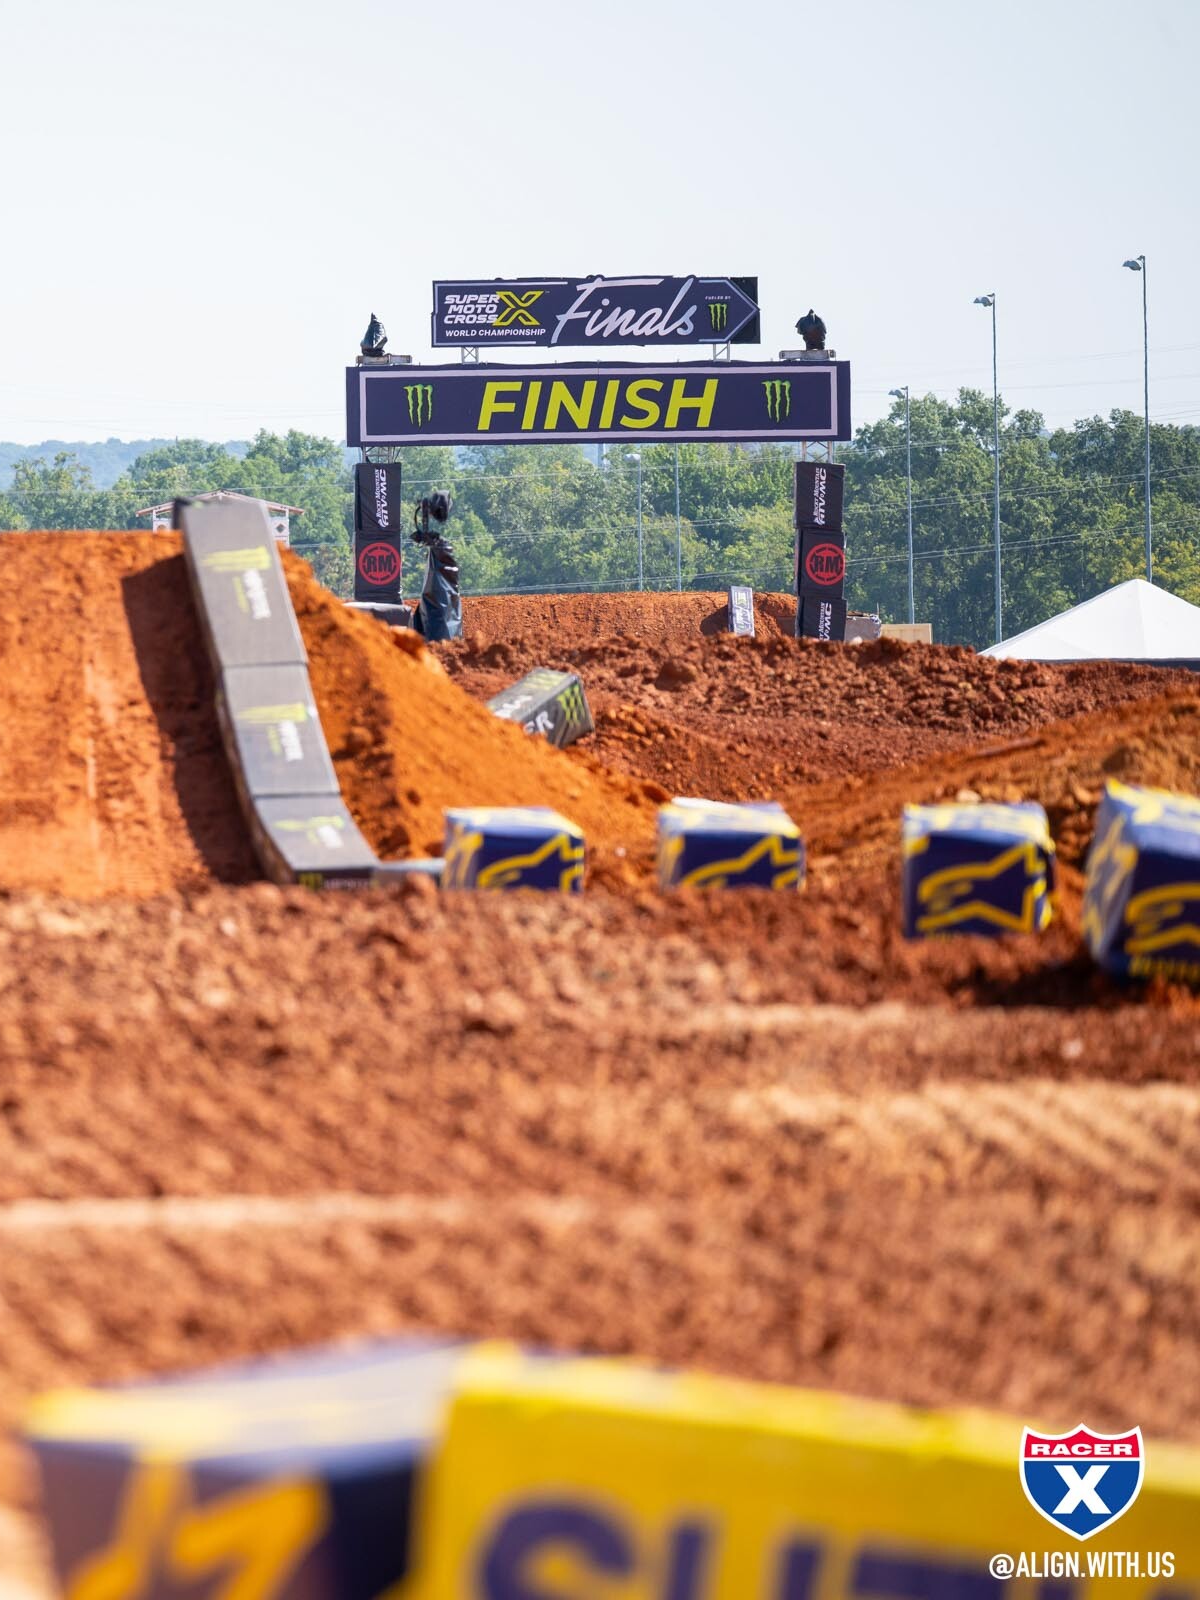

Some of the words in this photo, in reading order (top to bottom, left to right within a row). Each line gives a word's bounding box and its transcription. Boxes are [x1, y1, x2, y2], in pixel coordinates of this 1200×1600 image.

[444, 294, 499, 304] SUPER
[448, 304, 497, 314] MOTO
[551, 277, 697, 344] Finals
[443, 314, 498, 324] CROSS
[445, 329, 477, 337] WORLD
[479, 328, 546, 336] CHAMPIONSHIP
[477, 379, 719, 430] FINISH
[367, 555, 393, 573] RM
[814, 555, 840, 573] RM
